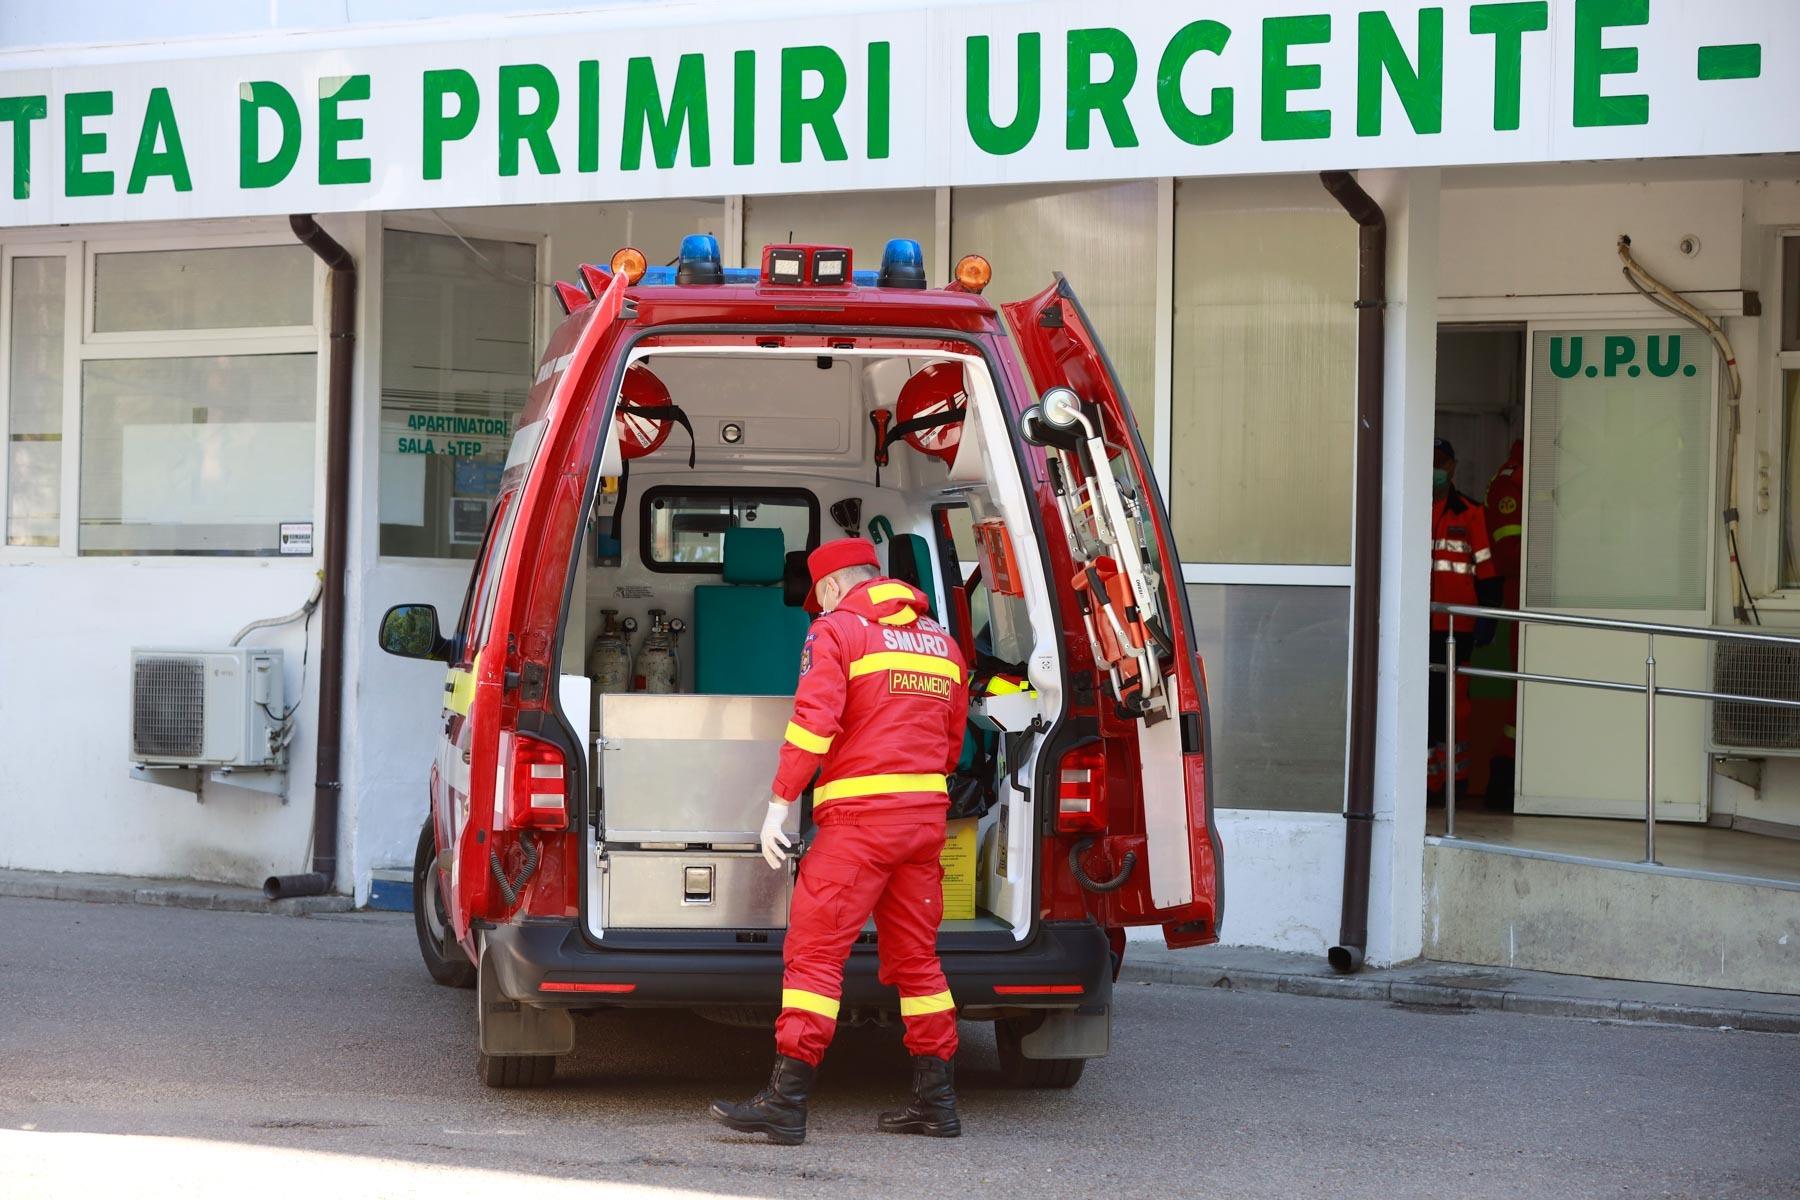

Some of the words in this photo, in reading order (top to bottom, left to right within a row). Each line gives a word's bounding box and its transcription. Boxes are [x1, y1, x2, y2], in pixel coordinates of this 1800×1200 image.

[0, 87, 193, 199] TEA
[239, 74, 371, 189] DE
[422, 41, 890, 181] PRIMIRI
[967, 0, 1650, 156] URGENTE
[1549, 335, 1697, 379] U.P.U.
[398, 438, 435, 454] SALA
[882, 627, 949, 657] SMURD
[893, 672, 950, 696] PARAMEDIC
